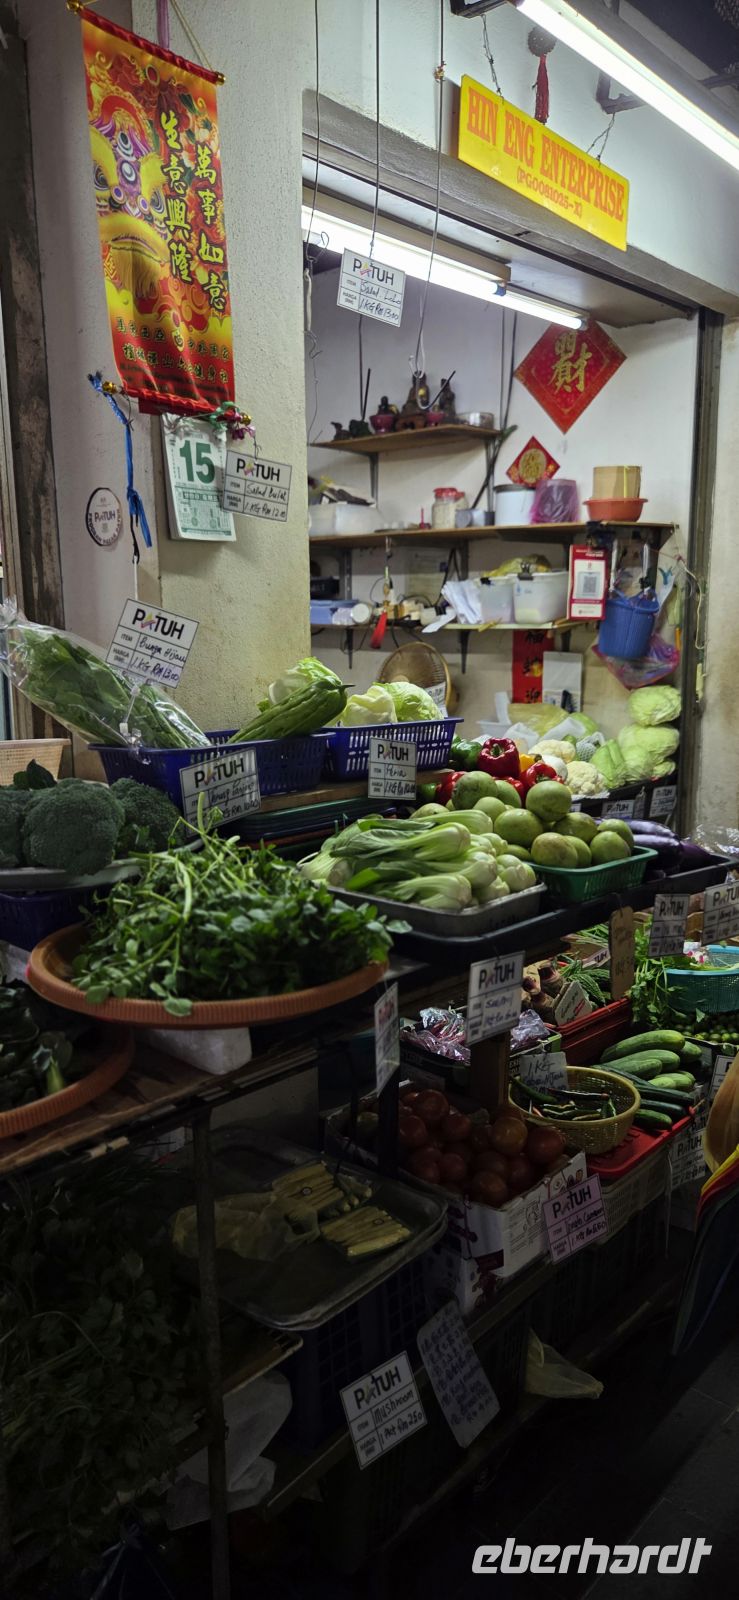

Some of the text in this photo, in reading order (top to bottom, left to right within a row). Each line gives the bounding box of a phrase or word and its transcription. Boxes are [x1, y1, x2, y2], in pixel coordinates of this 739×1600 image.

[159, 110, 193, 284] 生意興隆
[466, 86, 625, 223] HIN ENG ENTERPRISE
[179, 440, 216, 485] 15
